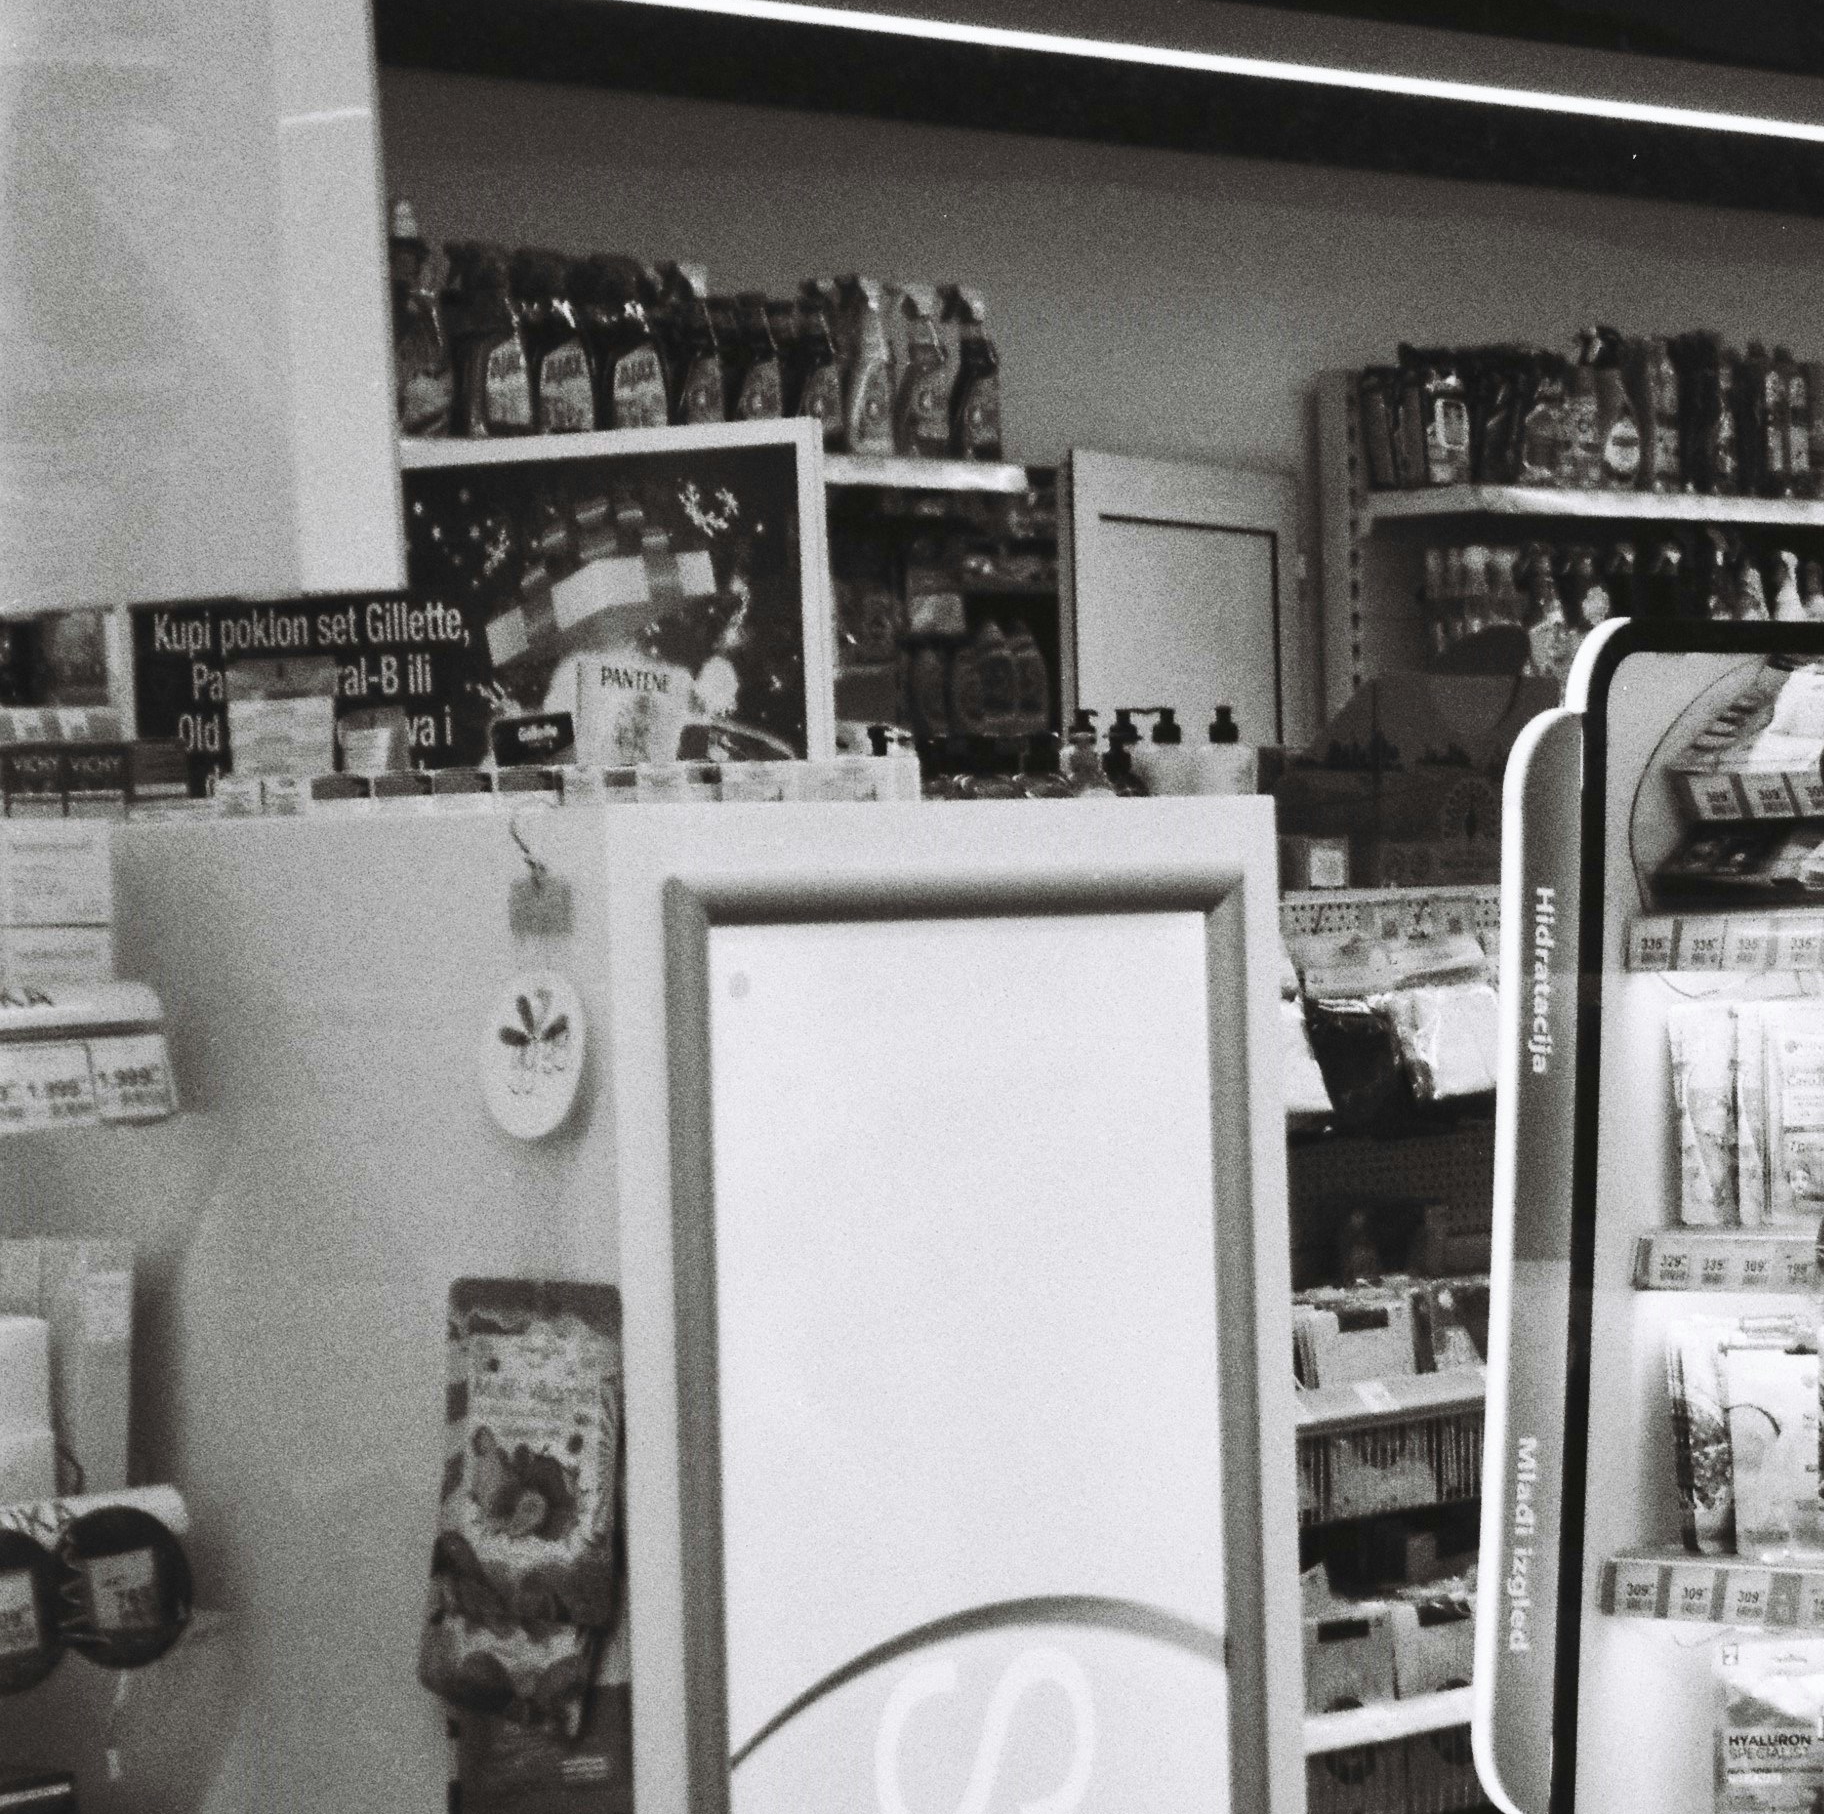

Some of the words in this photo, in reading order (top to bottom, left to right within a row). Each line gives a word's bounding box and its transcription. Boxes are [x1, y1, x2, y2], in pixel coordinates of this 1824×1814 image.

[153, 611, 213, 661] Kupi
[220, 609, 308, 656] poklon
[317, 606, 359, 646] set
[365, 602, 471, 647] Gillette,
[406, 653, 432, 694] ili
[600, 665, 671, 694] PANTENE
[178, 712, 220, 752] Old
[1528, 887, 1556, 1074] Hidratacija
[1507, 1547, 1534, 1652] izgled
[1729, 1733, 1812, 1746] HYALURON
